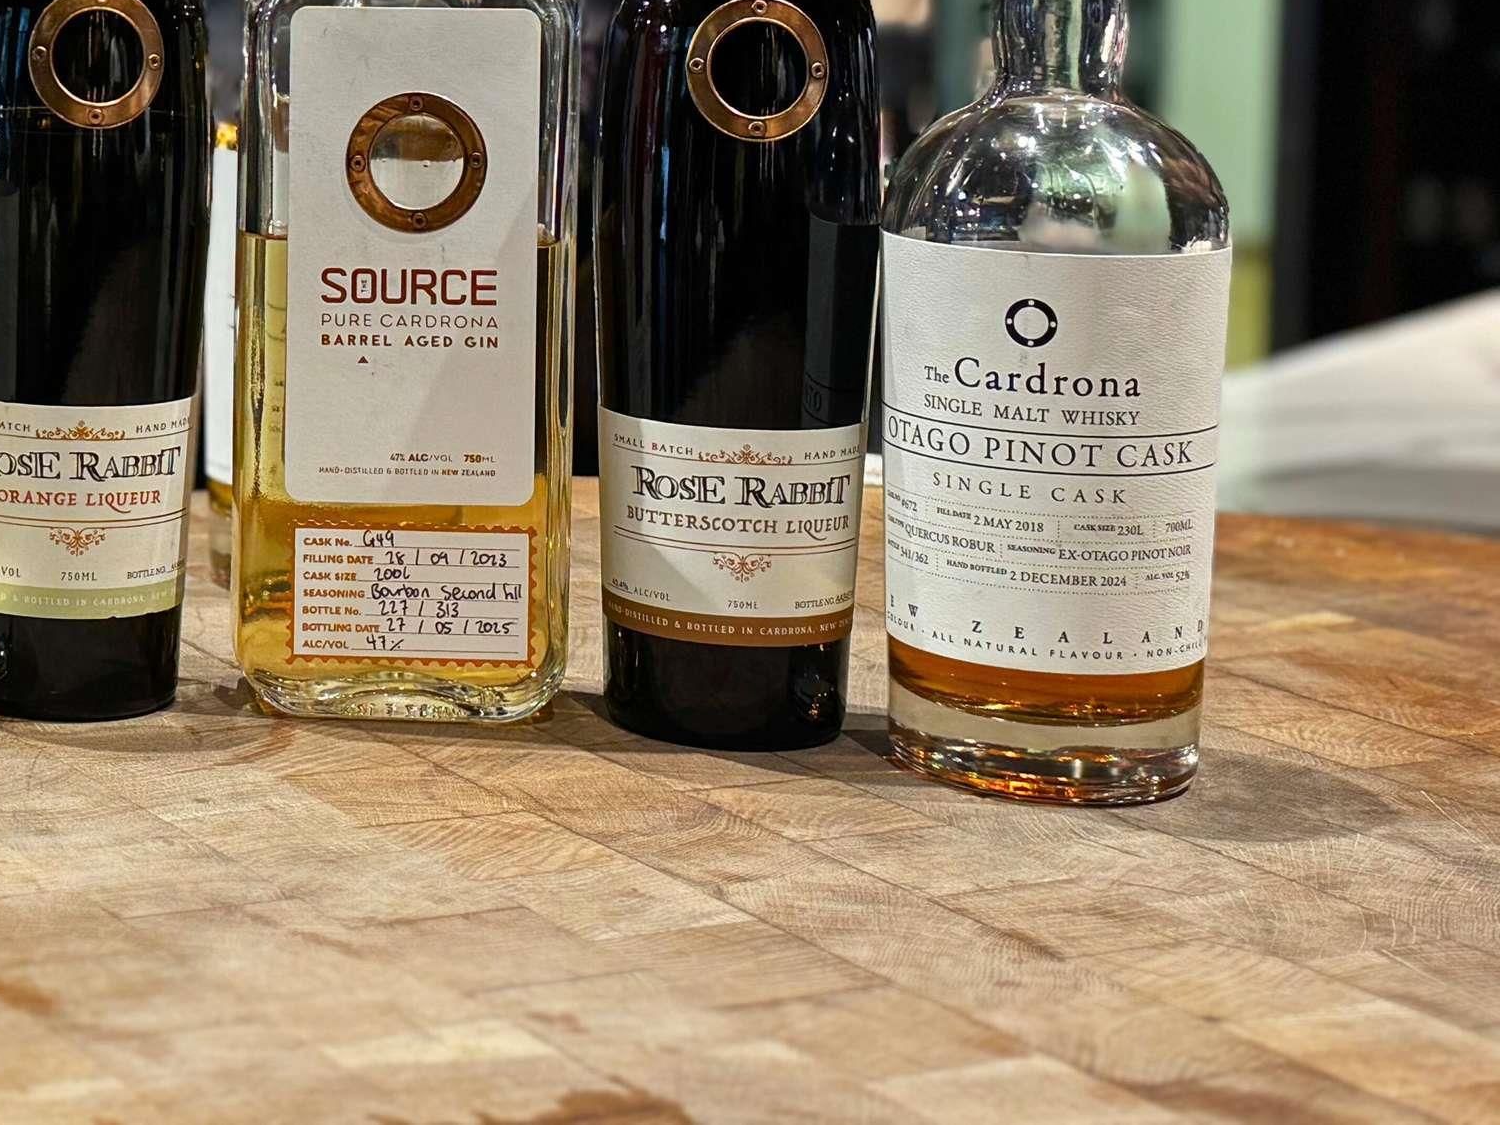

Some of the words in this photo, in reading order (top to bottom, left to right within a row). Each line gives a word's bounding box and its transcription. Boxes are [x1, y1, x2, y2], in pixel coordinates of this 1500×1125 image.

[320, 267, 498, 307] SOURCE
[321, 313, 373, 327] PURE
[380, 313, 499, 329] CARDRONA
[321, 334, 392, 347] BARREL
[404, 335, 453, 348] AGED
[464, 335, 499, 349] GIN
[924, 365, 949, 384] The
[954, 356, 1141, 398] Cardrona
[923, 393, 983, 417] SINGLE
[994, 404, 1050, 424] MALT
[1061, 409, 1140, 426] WHISKY
[136, 423, 166, 434] HAND
[613, 433, 645, 448] SMALL
[651, 442, 694, 456] BATCH
[804, 449, 836, 460] HAND
[888, 415, 971, 456] OTAGO
[984, 437, 1103, 467] PINOT
[1116, 440, 1194, 468] CASK
[69, 446, 181, 482] RABBIT
[408, 453, 453, 463] ALC/VOL
[464, 454, 496, 463] 750ML
[394, 467, 429, 475] BOTTLED
[431, 467, 439, 475] IN
[442, 468, 459, 476] NEW
[461, 468, 496, 477] ZEALAND
[629, 464, 726, 504] ROSE
[734, 474, 851, 509] RABBIT
[933, 472, 1031, 499] SINGLE
[1051, 486, 1127, 505] CASK
[85, 489, 162, 514] LIQUEUR
[626, 505, 778, 534] BUTTERSCOTCH
[785, 513, 850, 541] LIQUEUR
[974, 515, 981, 525] 2
[984, 516, 1013, 530] MAY
[1015, 519, 1044, 532] 2018
[1117, 525, 1144, 535] 230L
[303, 537, 332, 547] CASK
[905, 523, 950, 545] QUERCUS
[951, 535, 995, 554] ROBUR
[1007, 544, 1056, 555] SEASONING
[1059, 548, 1129, 562] EX-OTAGO
[1131, 548, 1167, 561] PINOT
[303, 554, 344, 564] FILLING
[346, 555, 374, 565] DATE
[470, 550, 507, 568] 2023
[60, 571, 98, 582] 750ML
[302, 571, 331, 581] CASK
[334, 572, 357, 581] SIZE
[1010, 570, 1017, 581] 2
[1020, 571, 1098, 587] DECEMBER
[1099, 575, 1127, 587] 2024
[302, 589, 366, 598] SEASONING
[632, 586, 670, 601] ALC/VOL
[726, 600, 758, 610] 750ML
[301, 605, 341, 615] BOTTLE
[301, 622, 352, 633] BOTTLING
[355, 623, 381, 633] DATE
[475, 620, 512, 635] 2025
[687, 622, 735, 634] BOTTLED
[741, 626, 753, 635] IN
[301, 639, 349, 649] ALC/VOL
[932, 630, 954, 643] ALL
[963, 638, 1037, 656] NATURAL
[1050, 649, 1123, 660] FLAVOUR
